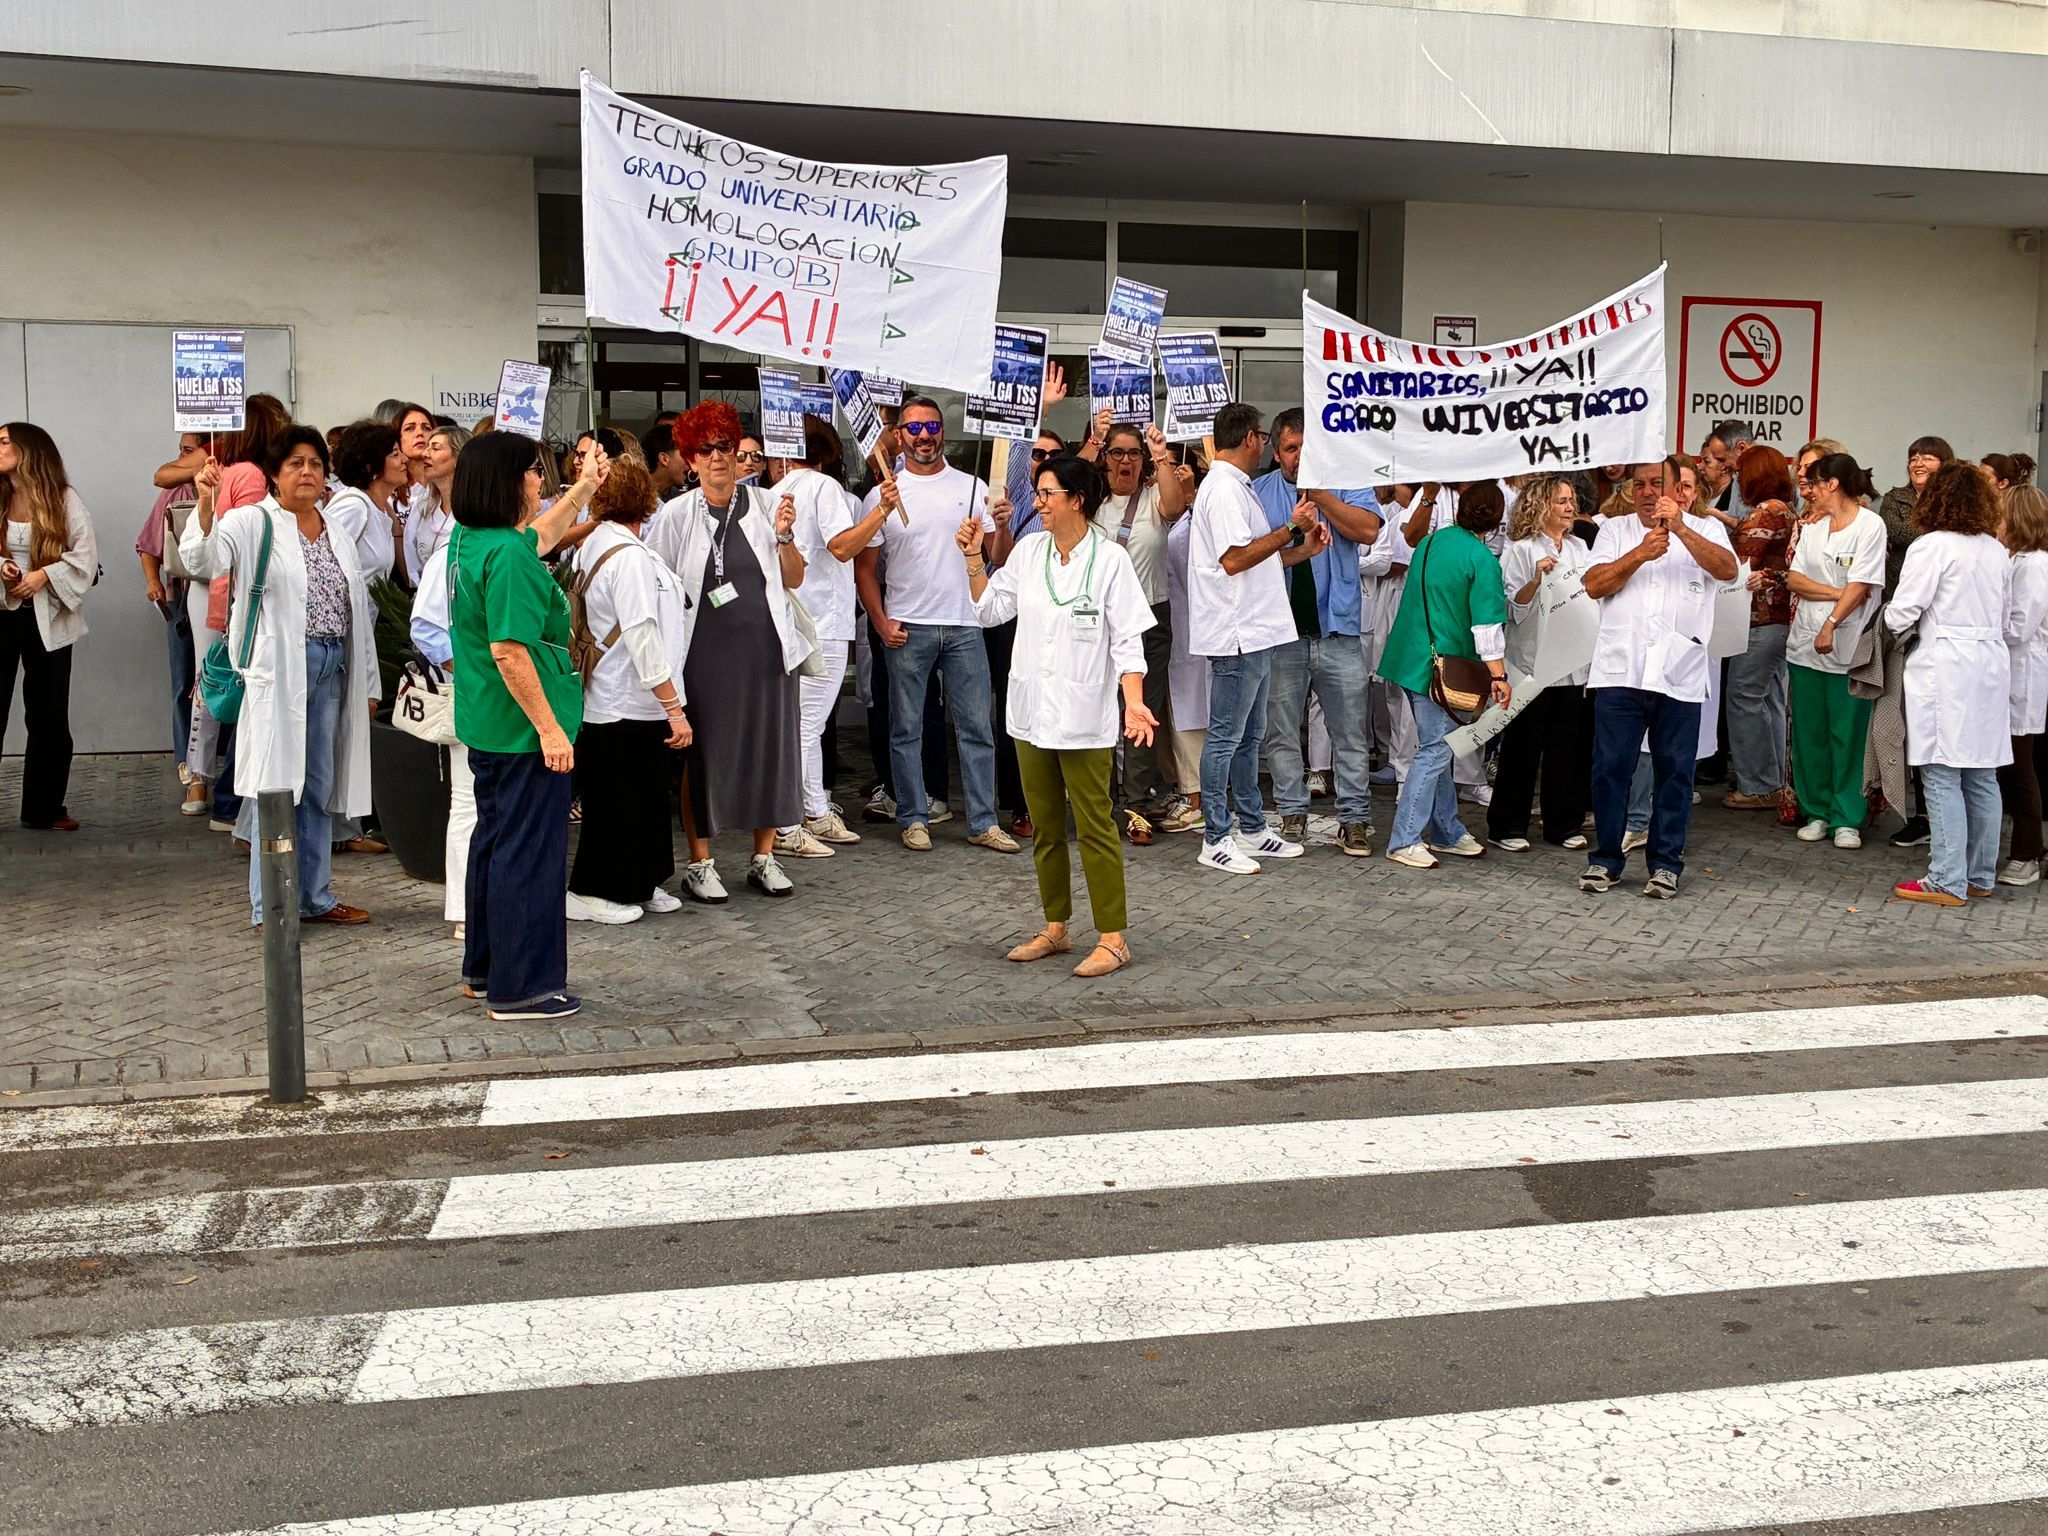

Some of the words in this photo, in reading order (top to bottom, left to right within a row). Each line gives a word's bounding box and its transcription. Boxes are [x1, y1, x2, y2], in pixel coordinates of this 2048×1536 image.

[623, 154, 707, 192] GRADO
[683, 237, 795, 280] GRUPO
[808, 262, 831, 287] B
[1107, 313, 1140, 335] HUELGA
[1141, 322, 1157, 340] TSS
[177, 376, 220, 395] HUELGA
[222, 376, 243, 395] TSS
[1016, 384, 1038, 406] TSS
[1169, 384, 1208, 405] HUELGA
[1207, 382, 1227, 402] TSS
[1132, 393, 1150, 412] TSS
[1422, 386, 1650, 436] UNIVERSITARIO
[1691, 392, 1805, 416] PROHIBIDO
